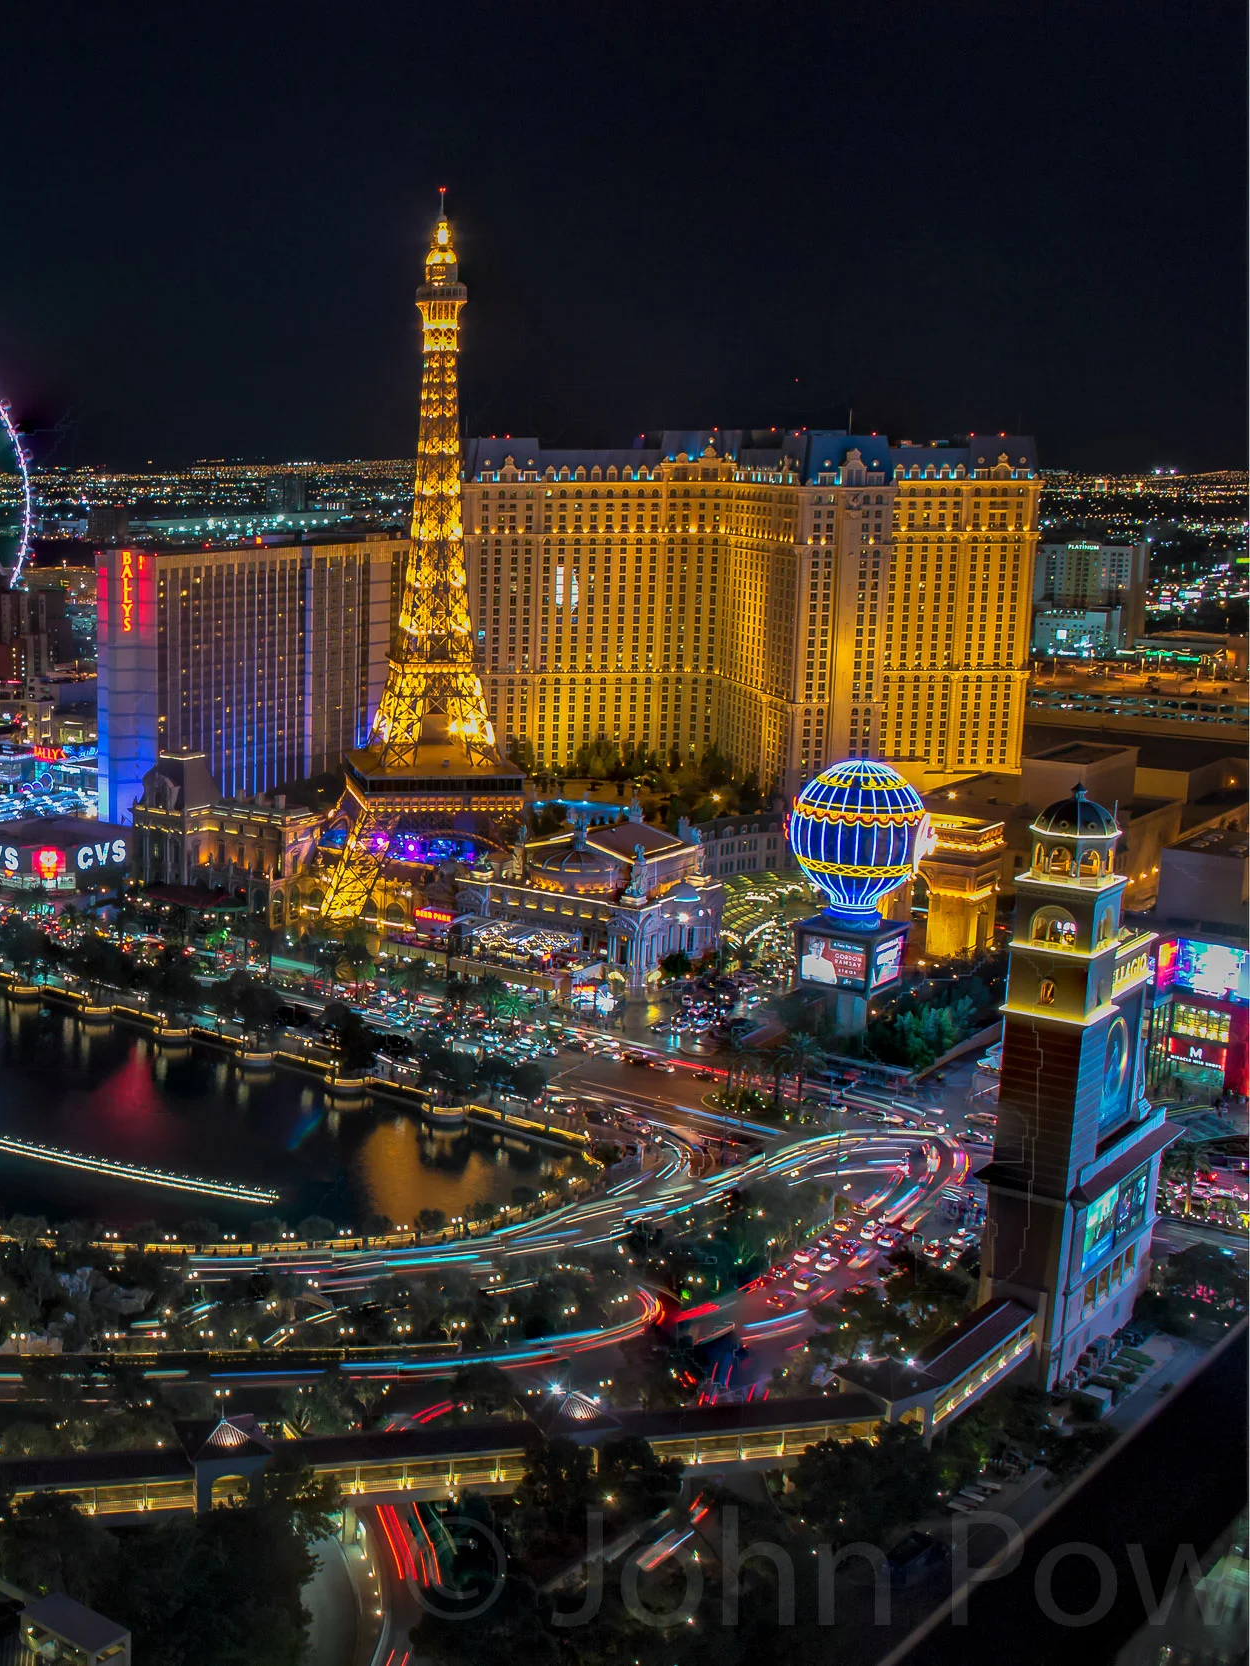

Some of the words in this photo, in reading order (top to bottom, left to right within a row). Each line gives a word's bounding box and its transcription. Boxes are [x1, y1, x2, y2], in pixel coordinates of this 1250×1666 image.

[1067, 541, 1100, 551] PLATINUM
[76, 838, 127, 870] CVS
[415, 909, 433, 919] BEER
[433, 912, 451, 922] PARK
[835, 953, 863, 963] GORDON
[835, 959, 862, 968] RAMSAY
[1190, 1046, 1203, 1060] M
